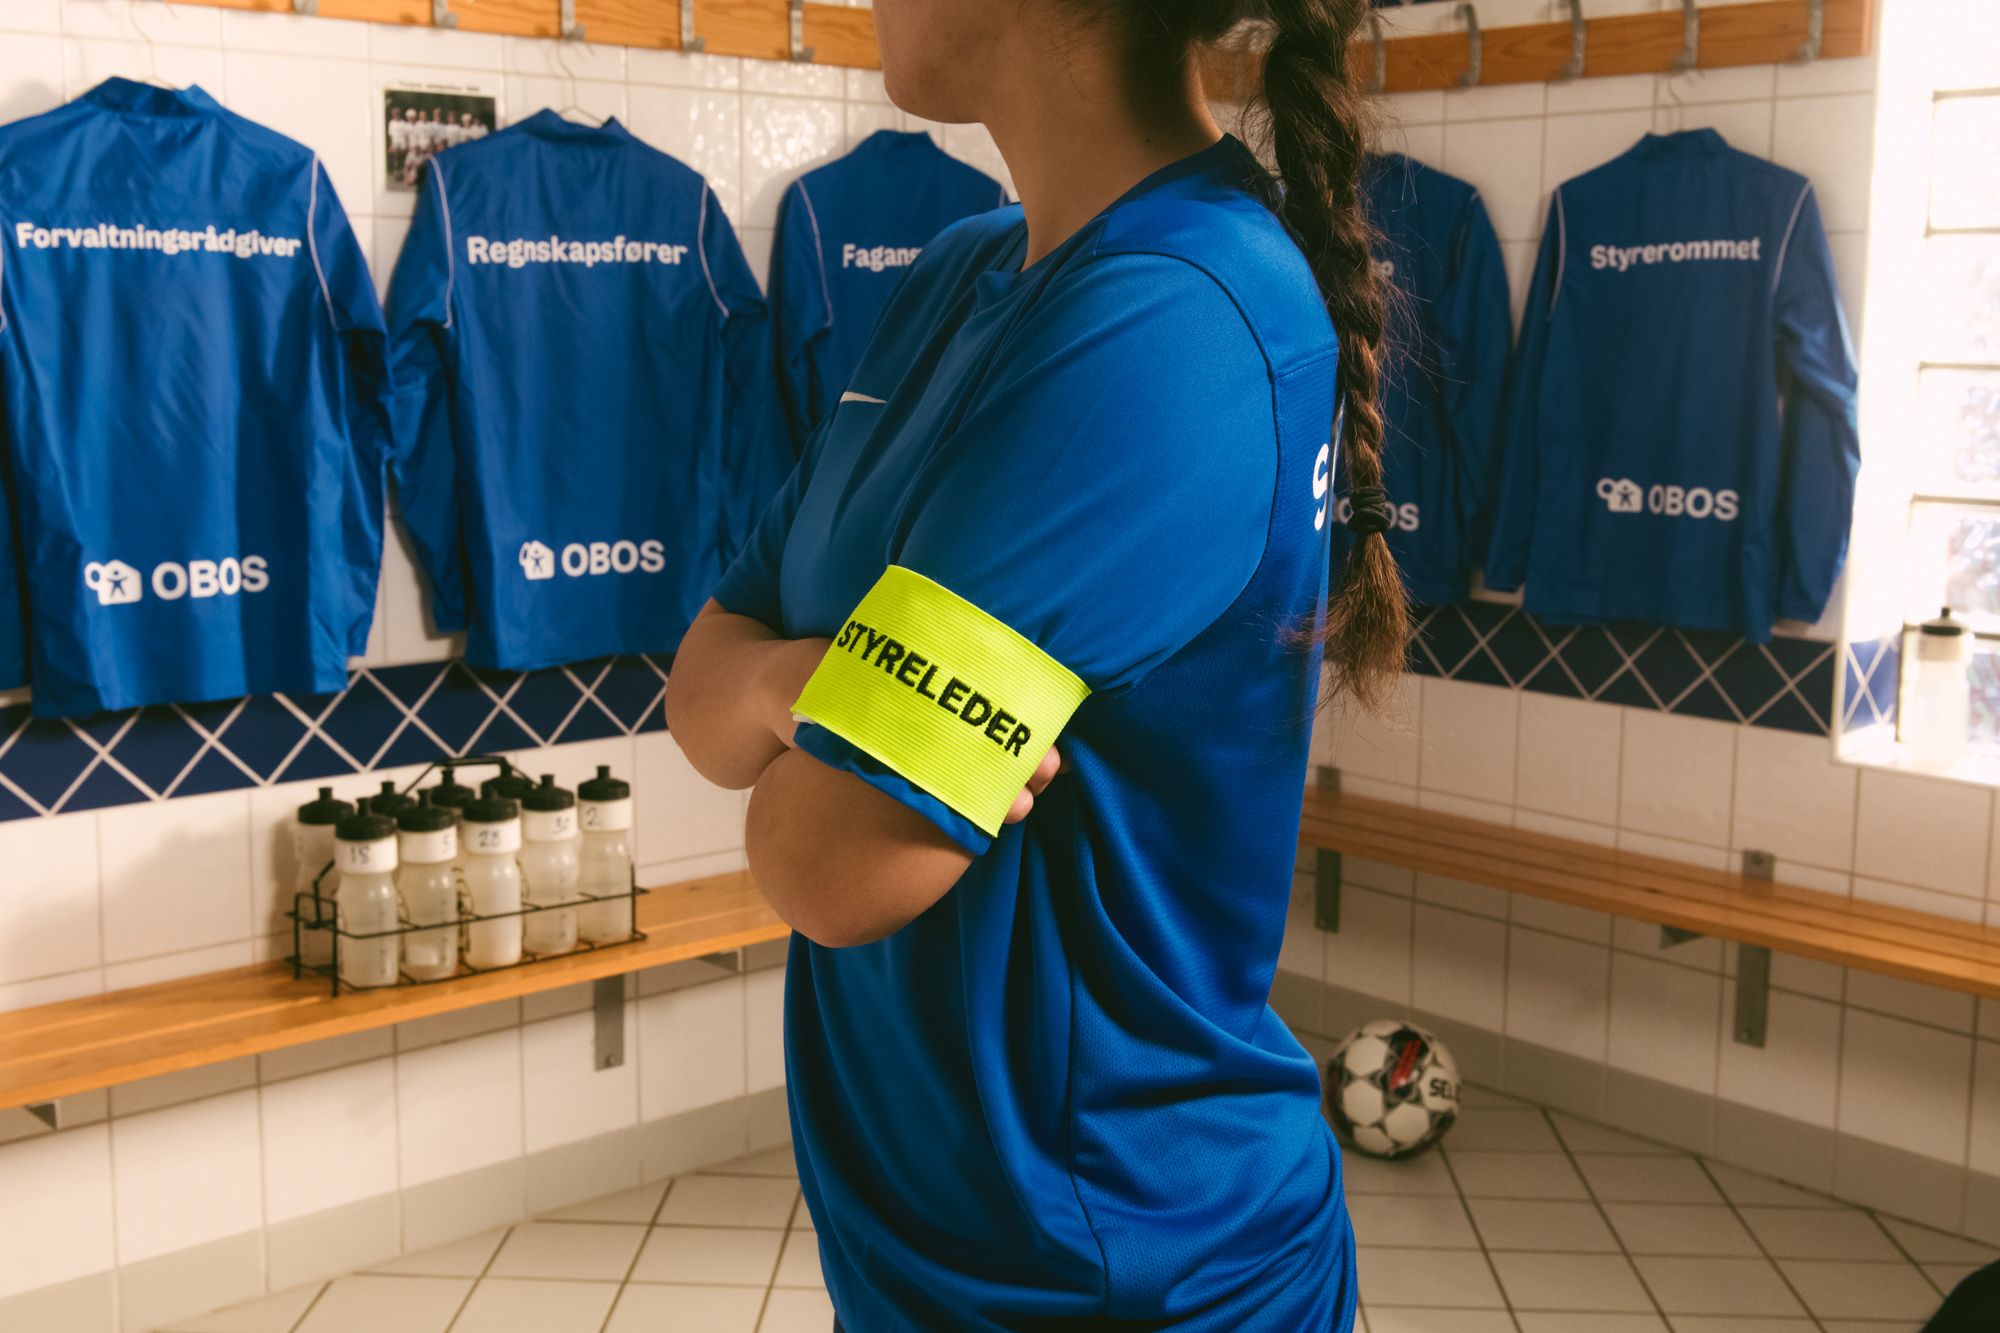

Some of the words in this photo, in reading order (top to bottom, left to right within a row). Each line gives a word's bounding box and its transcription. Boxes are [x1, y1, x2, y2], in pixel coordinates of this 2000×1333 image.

[16, 222, 301, 258] Forvaltningsrådgiver
[467, 234, 688, 268] Regnskapsfører
[1591, 236, 1761, 272] Styrerommet
[1648, 484, 1739, 521] OBOS
[561, 539, 665, 578] OBOS
[152, 554, 269, 601] OBOS
[837, 619, 1031, 758] STYRELEDER
